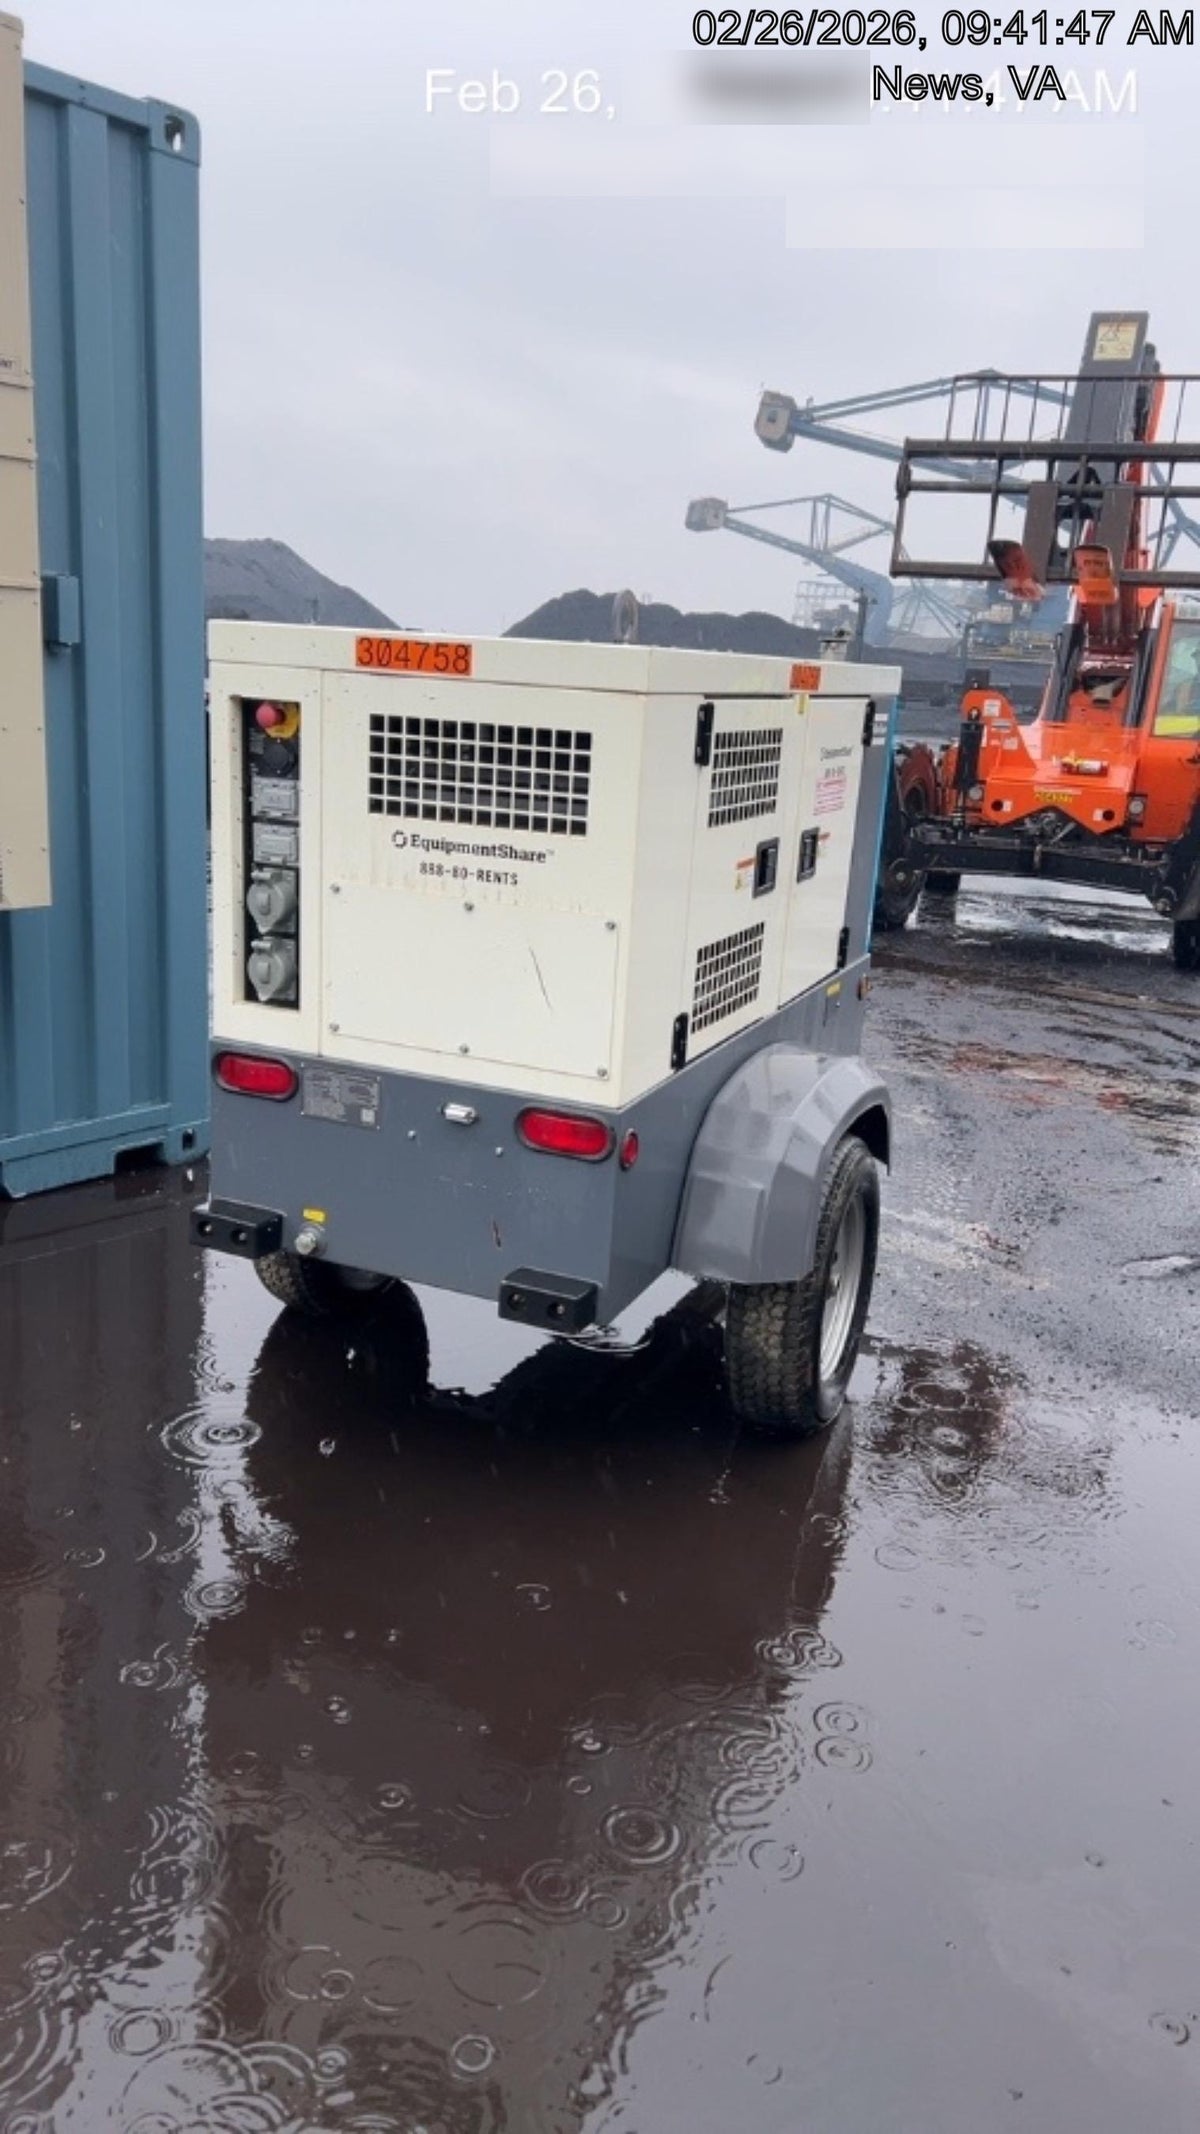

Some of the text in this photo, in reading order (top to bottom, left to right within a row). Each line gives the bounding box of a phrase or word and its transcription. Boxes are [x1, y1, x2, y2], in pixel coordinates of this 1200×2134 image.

[357, 637, 471, 674] 304758
[410, 833, 547, 864] EquipmentShare
[419, 861, 519, 886] 888-80-RENTS
